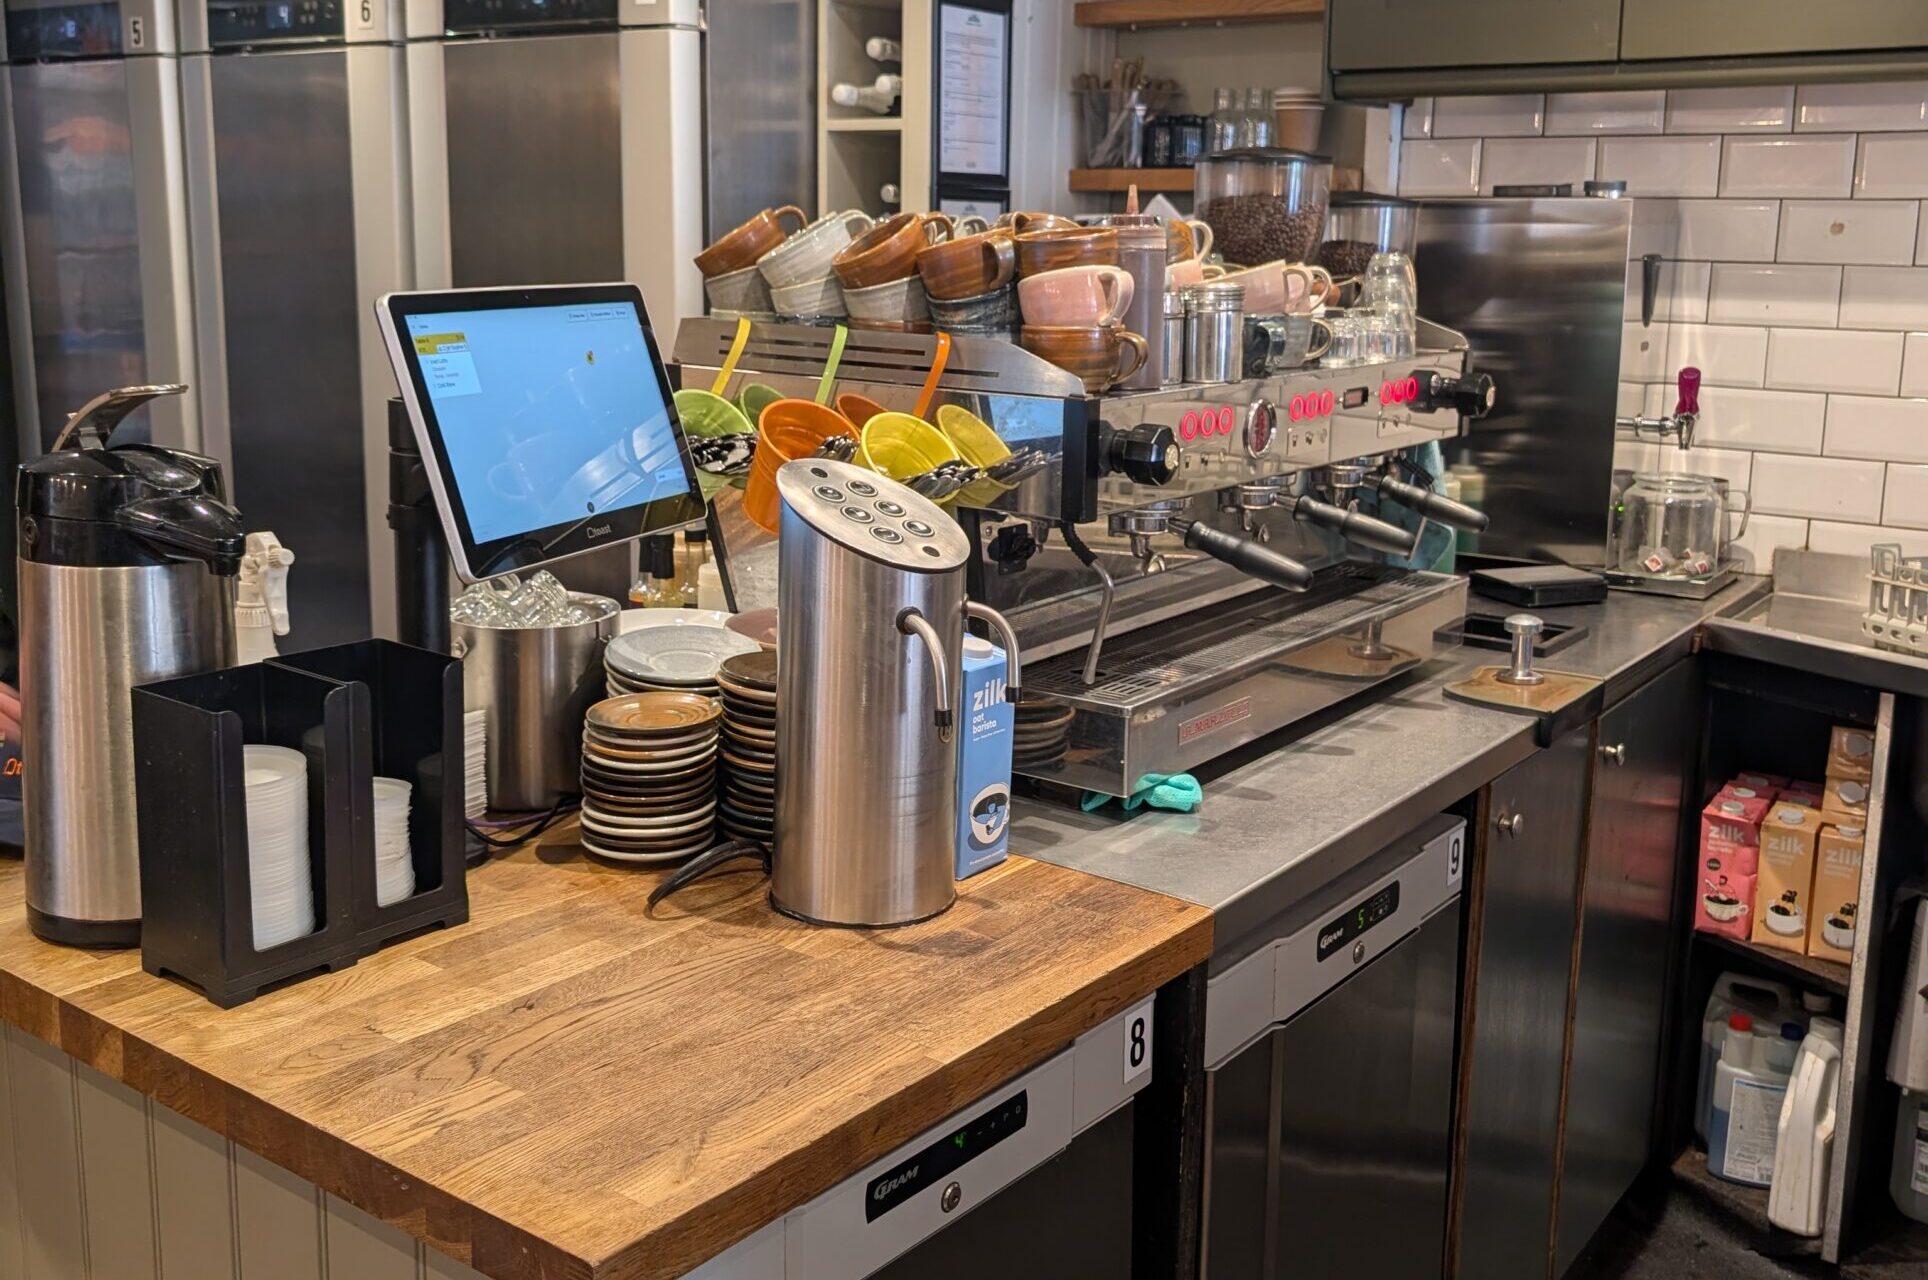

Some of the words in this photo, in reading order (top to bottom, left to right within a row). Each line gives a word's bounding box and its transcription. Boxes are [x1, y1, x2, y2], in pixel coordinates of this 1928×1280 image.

[360, 0, 371, 22] 6
[132, 20, 142, 45] 5
[593, 523, 612, 537] toast
[973, 678, 1007, 711] zilk
[972, 720, 997, 734] barista
[973, 713, 984, 723] oat
[1708, 825, 1744, 843] zilk
[1451, 838, 1460, 875] 9
[1767, 836, 1805, 856] zilk
[1130, 1017, 1145, 1068] 8
